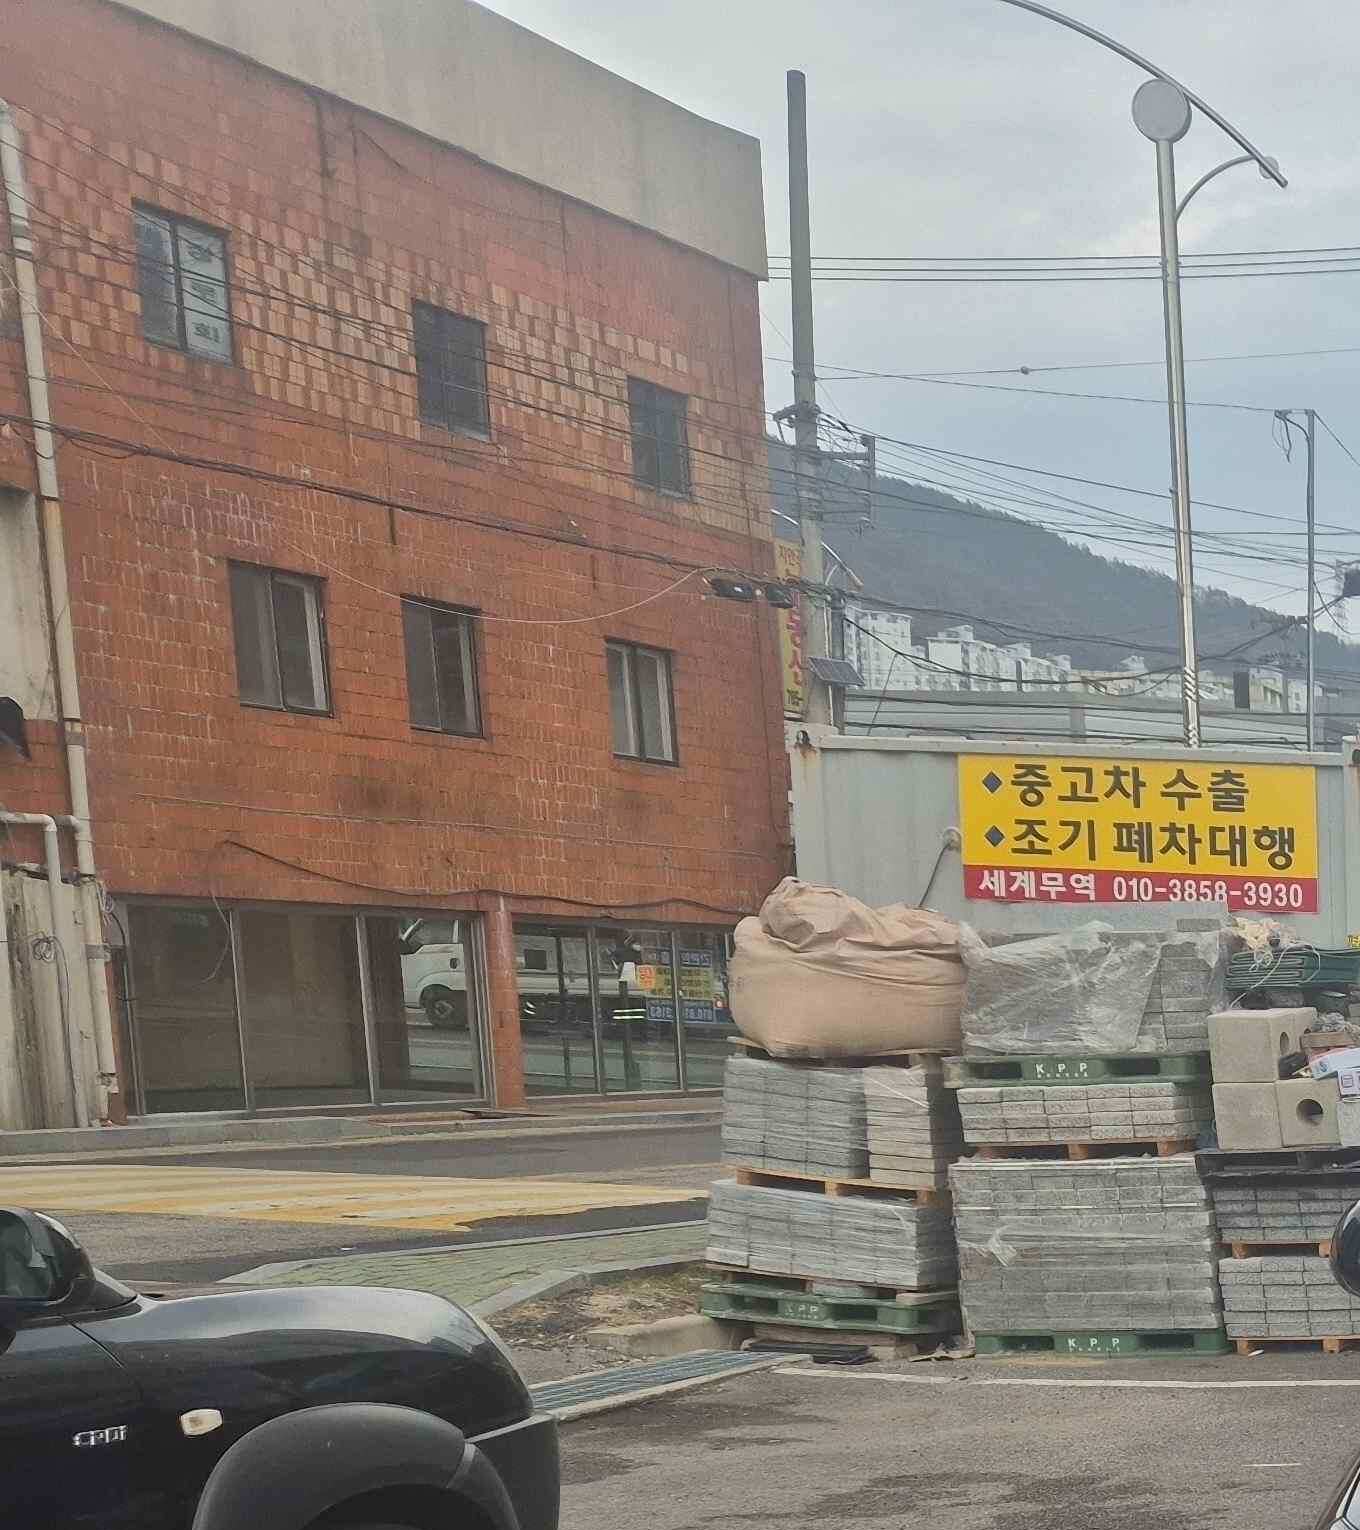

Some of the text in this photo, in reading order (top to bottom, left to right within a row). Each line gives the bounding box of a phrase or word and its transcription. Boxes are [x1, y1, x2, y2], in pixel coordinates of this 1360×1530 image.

[1011, 764, 1248, 812] 중고차 수출
[1011, 819, 1295, 870] 조기 폐차대행
[979, 869, 1303, 908] 세계무역 010-3858-3930
